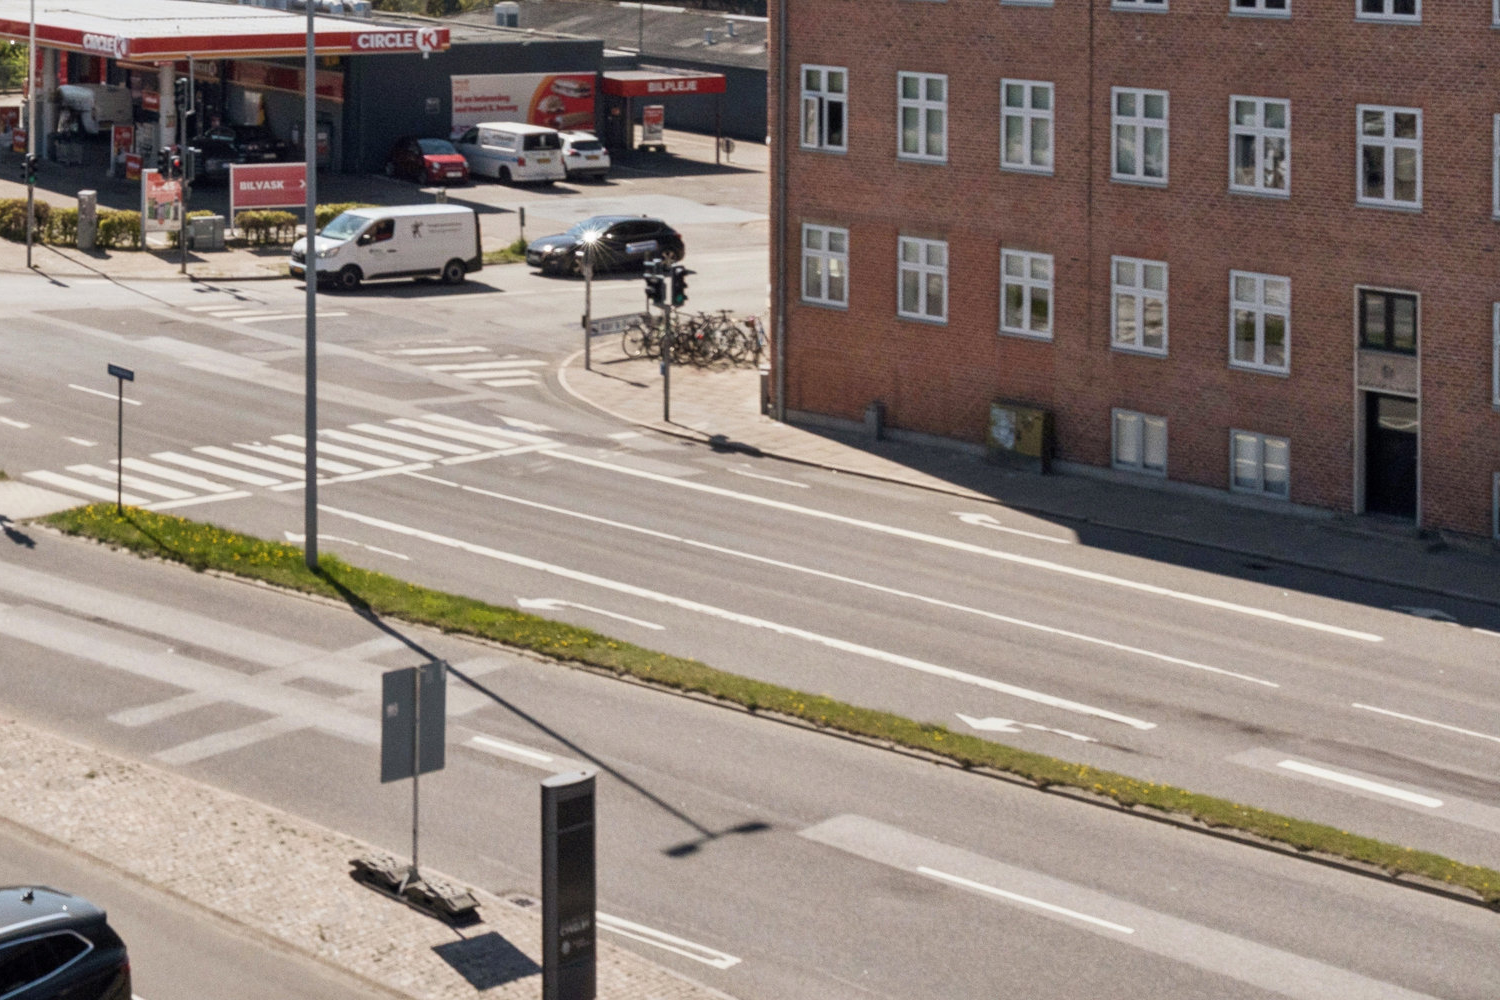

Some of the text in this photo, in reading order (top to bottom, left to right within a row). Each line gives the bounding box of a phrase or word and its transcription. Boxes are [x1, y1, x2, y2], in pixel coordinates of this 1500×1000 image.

[83, 34, 116, 51] CIRCLE
[357, 30, 437, 51] CIRCLE K
[647, 80, 698, 93] BILPLEJE
[239, 180, 284, 191] BILVASK
